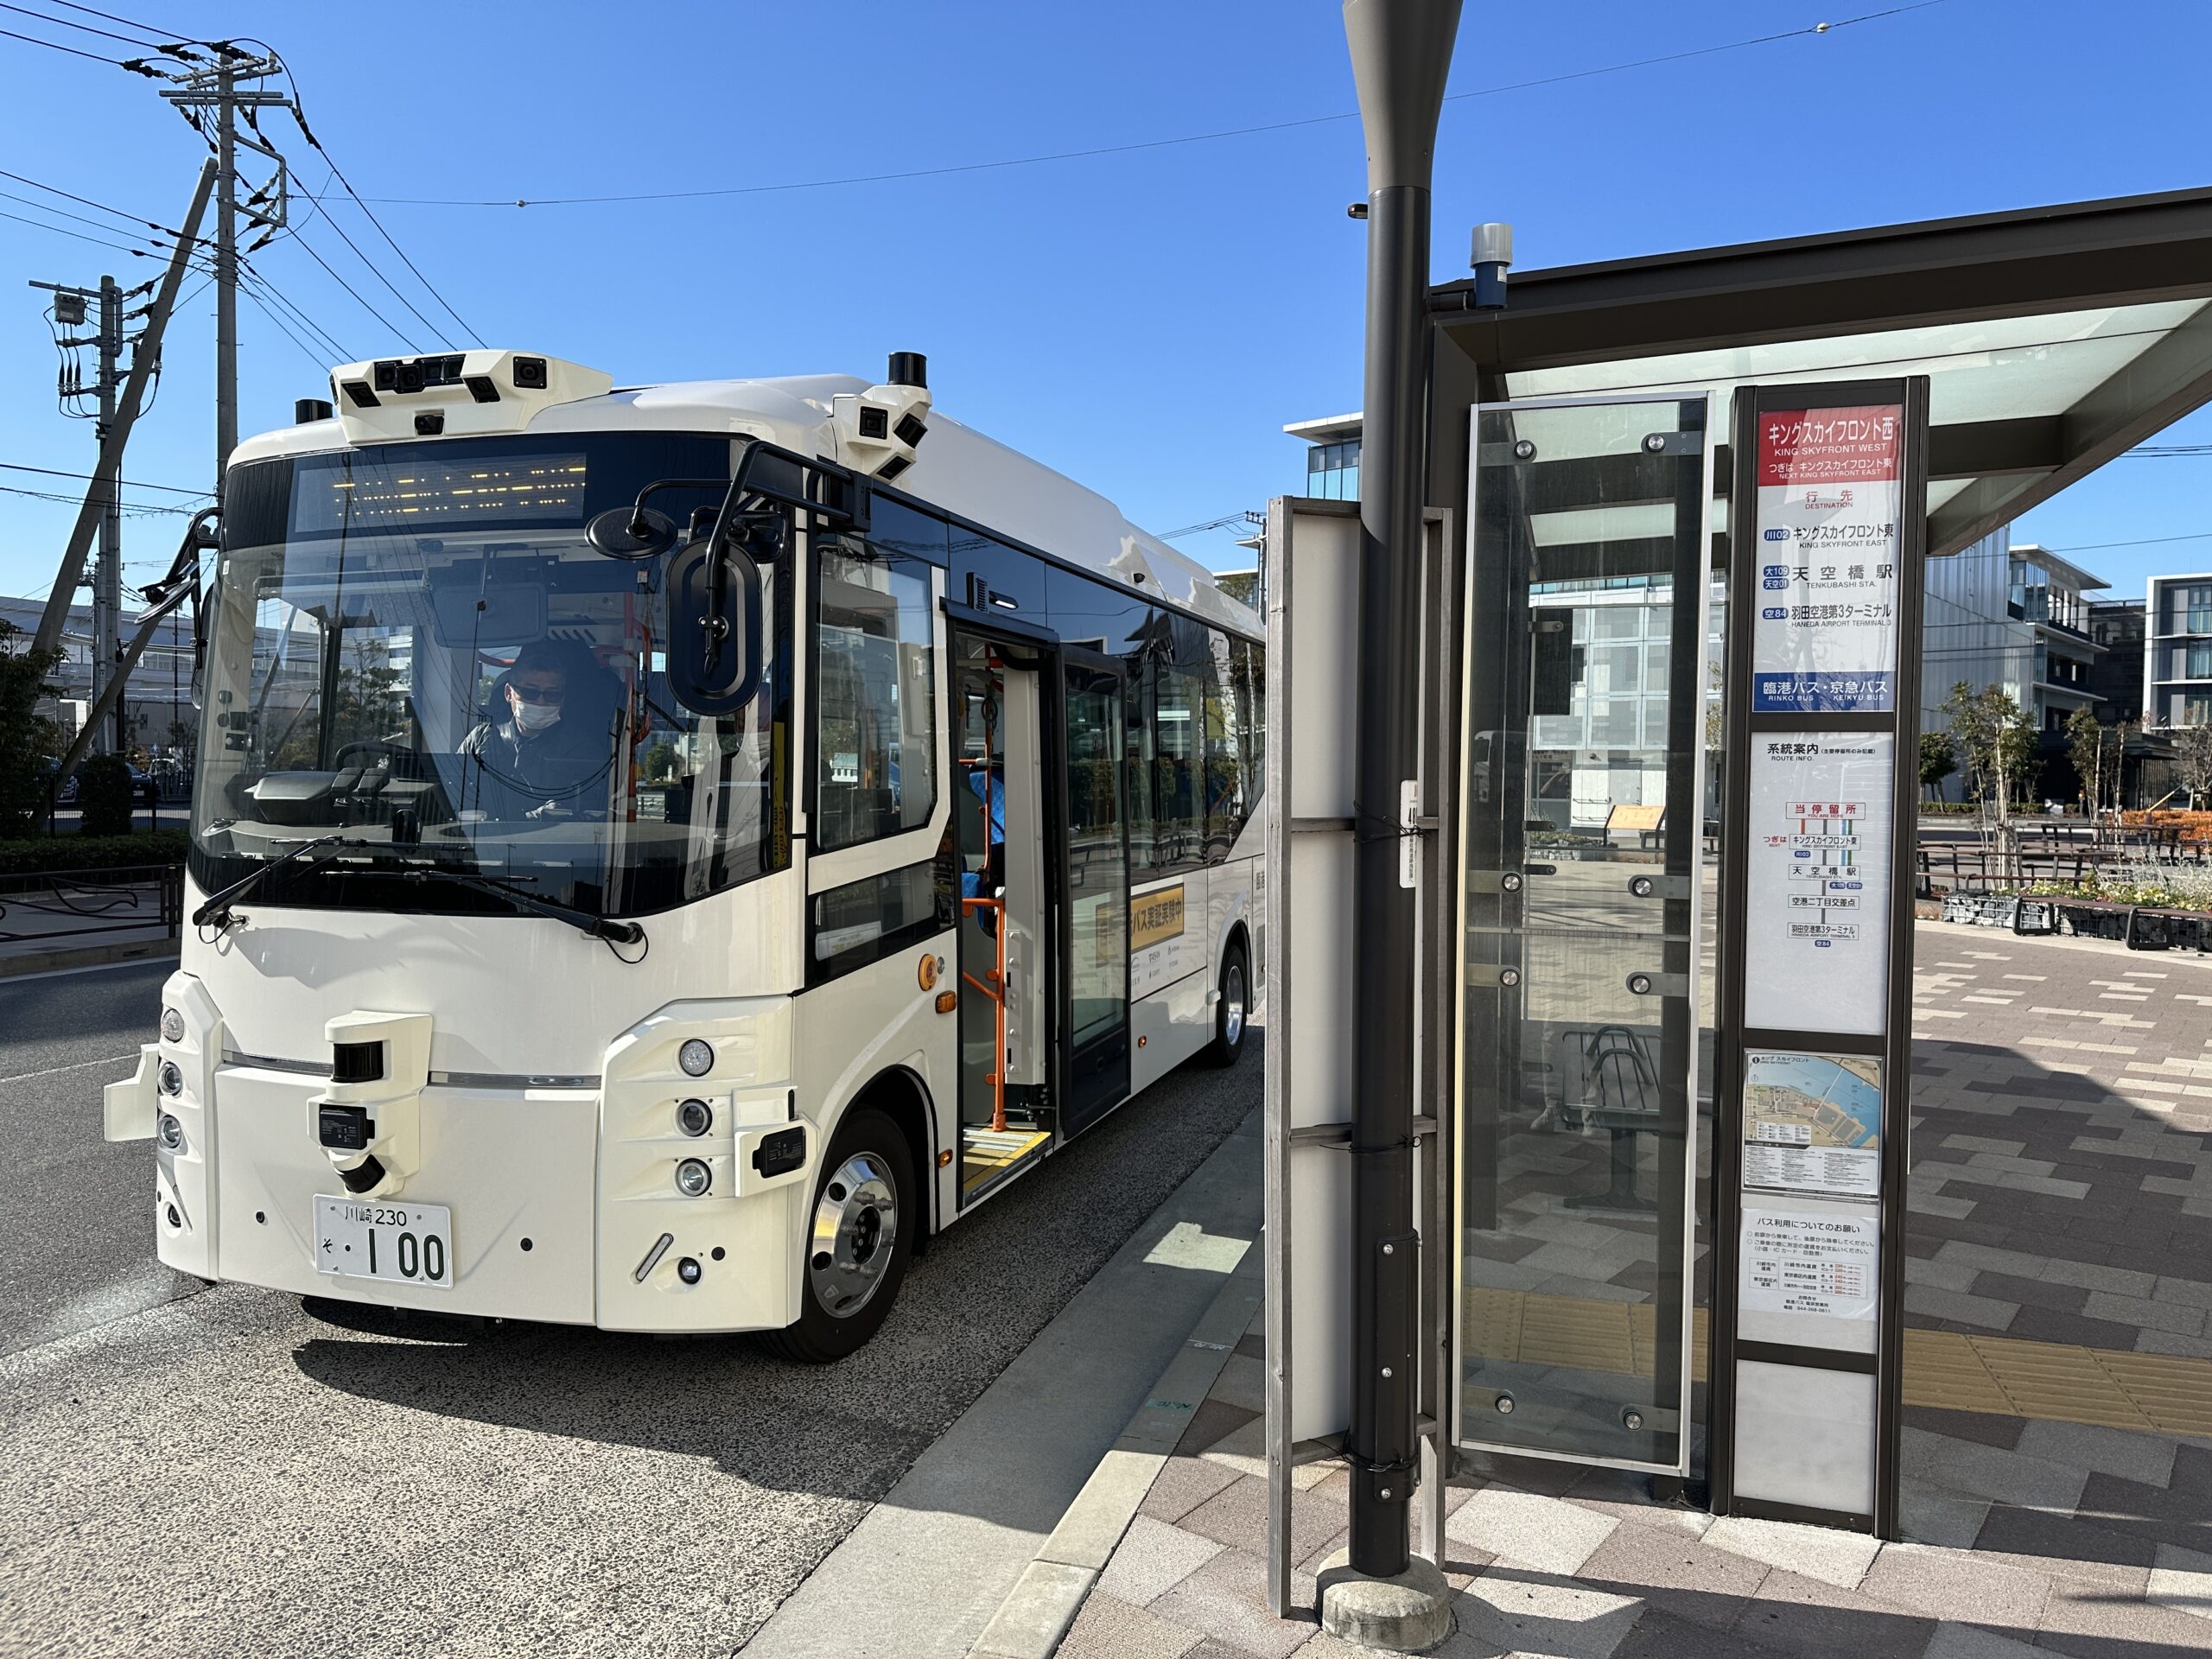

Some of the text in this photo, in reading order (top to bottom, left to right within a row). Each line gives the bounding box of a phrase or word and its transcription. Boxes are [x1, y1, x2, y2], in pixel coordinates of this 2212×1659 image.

[1769, 416, 1894, 446] キングスカイフロント西
[1775, 442, 1887, 456] KING SKYFRONT WEST
[1769, 457, 1892, 474] つぎは キングスカイフロント東
[1765, 523, 1894, 540] 川02 キングスカイフロント東
[1765, 564, 1892, 582] 大109 天空橋駅
[1764, 579, 1788, 588] 天空01
[1806, 581, 1857, 589] TENKUBASHI
[1764, 604, 1891, 620] 空84 羽田空港第3ターミナル
[1767, 743, 1818, 754] 系統案内
[1795, 804, 1856, 814] 当停留所
[1793, 836, 1857, 845] キングスカイフロント東
[1792, 897, 1855, 907] 空港二丁目交差点
[1131, 899, 1181, 937] バス実証実験中
[1791, 925, 1855, 934] 羽田空港第3ターミナル
[1757, 1217, 1860, 1233] バス利用についてのお願い
[322, 1237, 333, 1254] そ
